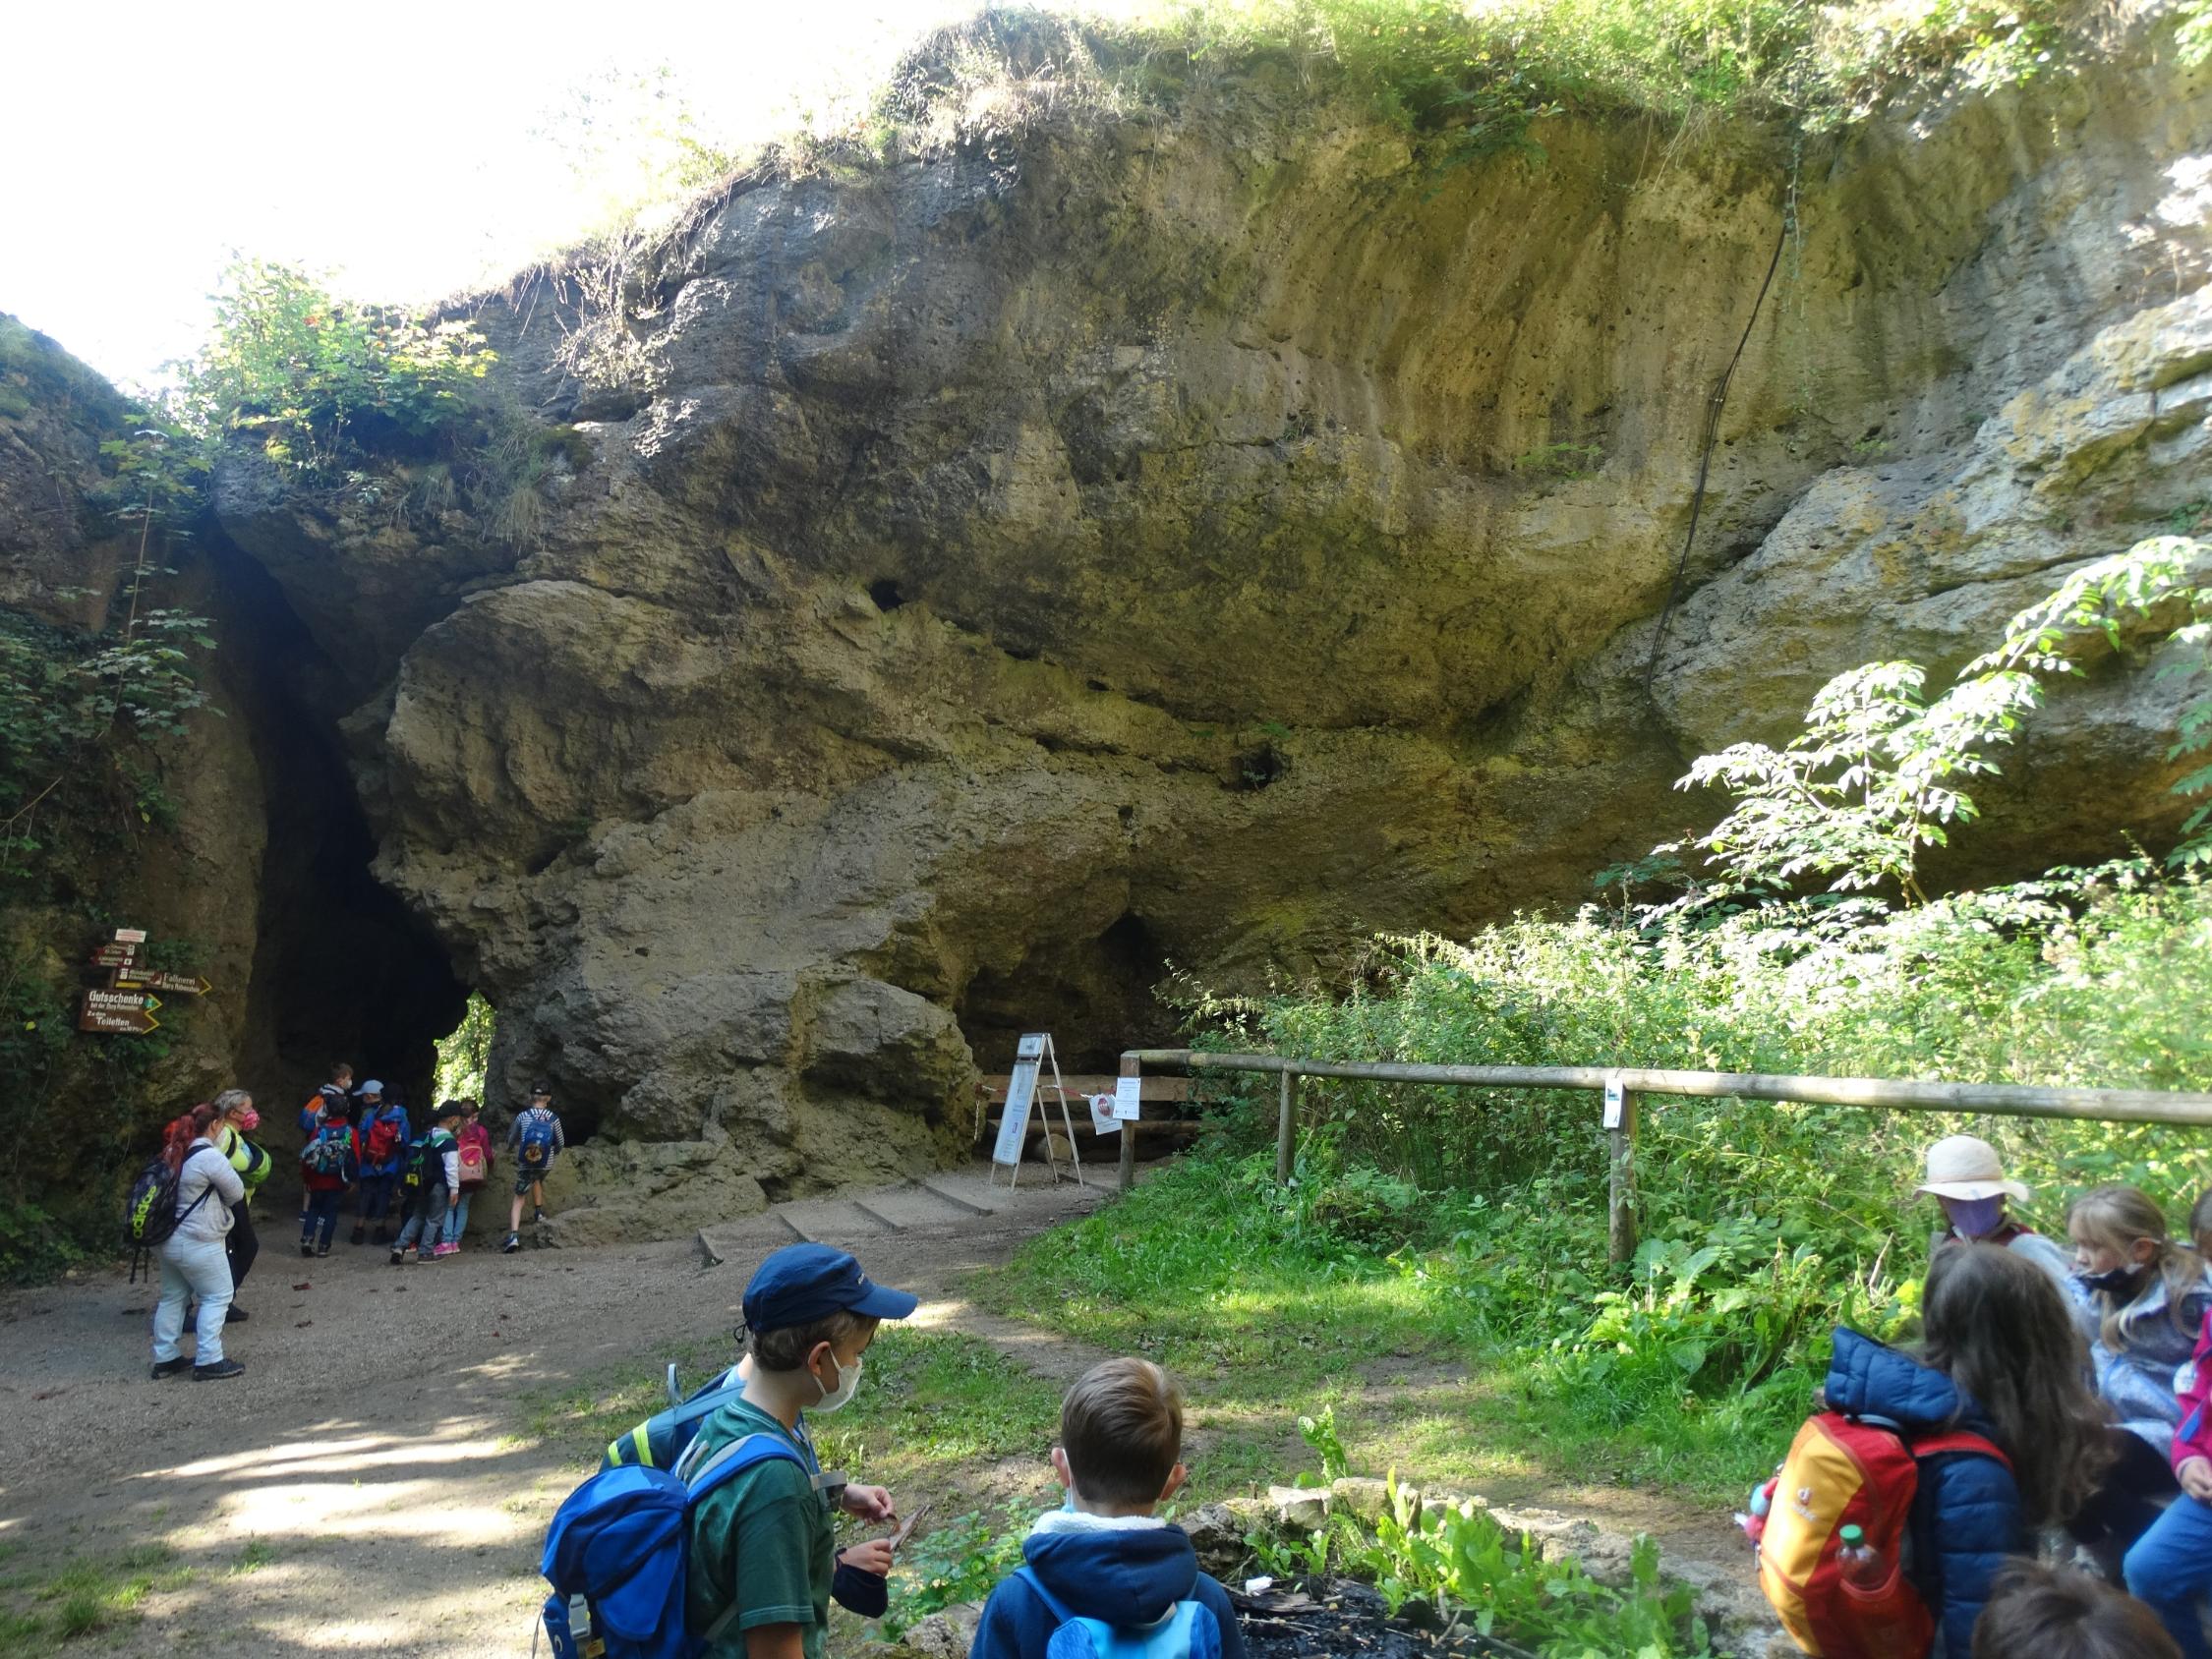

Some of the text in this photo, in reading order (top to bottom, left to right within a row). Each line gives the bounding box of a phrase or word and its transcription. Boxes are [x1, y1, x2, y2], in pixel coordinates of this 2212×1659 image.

[88, 990, 145, 1005] Gutsschenke
[96, 1016, 130, 1026] Toiletten
[132, 1185, 157, 1240] adidas
